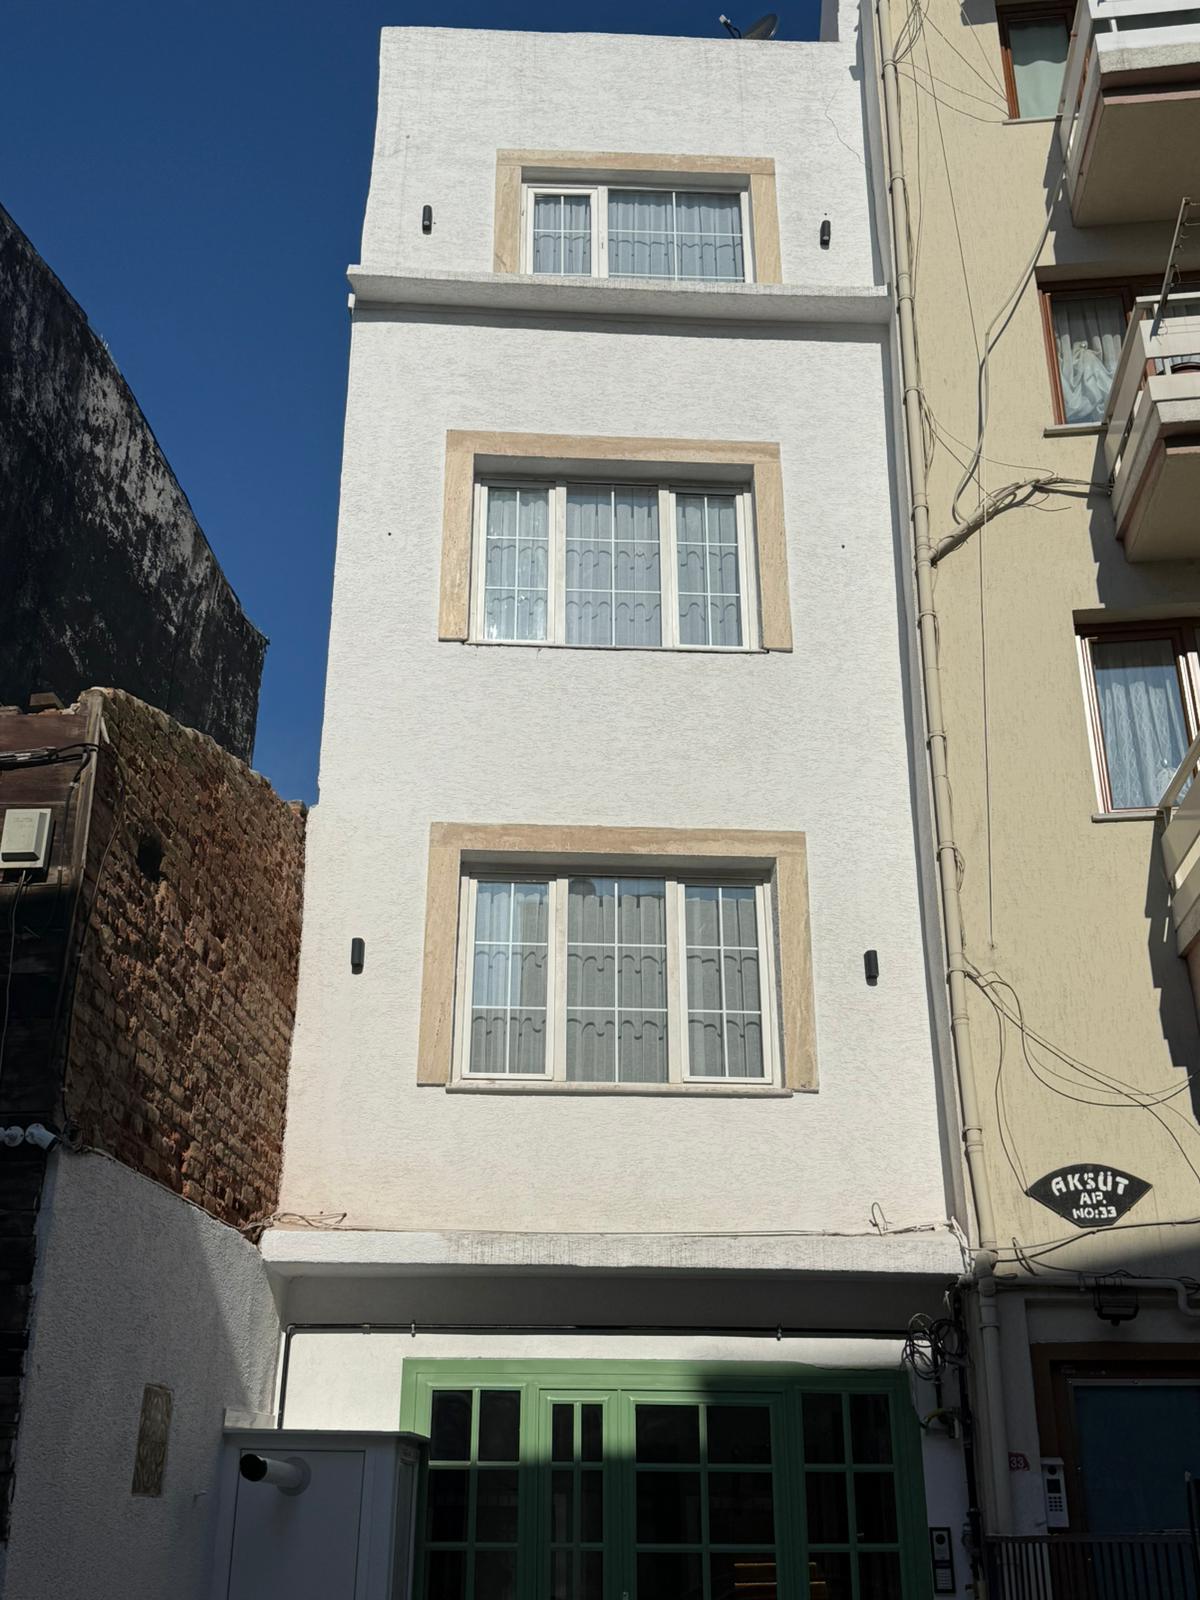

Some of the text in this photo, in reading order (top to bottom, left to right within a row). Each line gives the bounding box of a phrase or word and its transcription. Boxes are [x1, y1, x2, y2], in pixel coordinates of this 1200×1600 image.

[1051, 1171, 1129, 1196] AKSÜT
[1080, 1191, 1107, 1205] AP.
[1072, 1206, 1117, 1219] NO:33
[1009, 1456, 1025, 1468] 33
